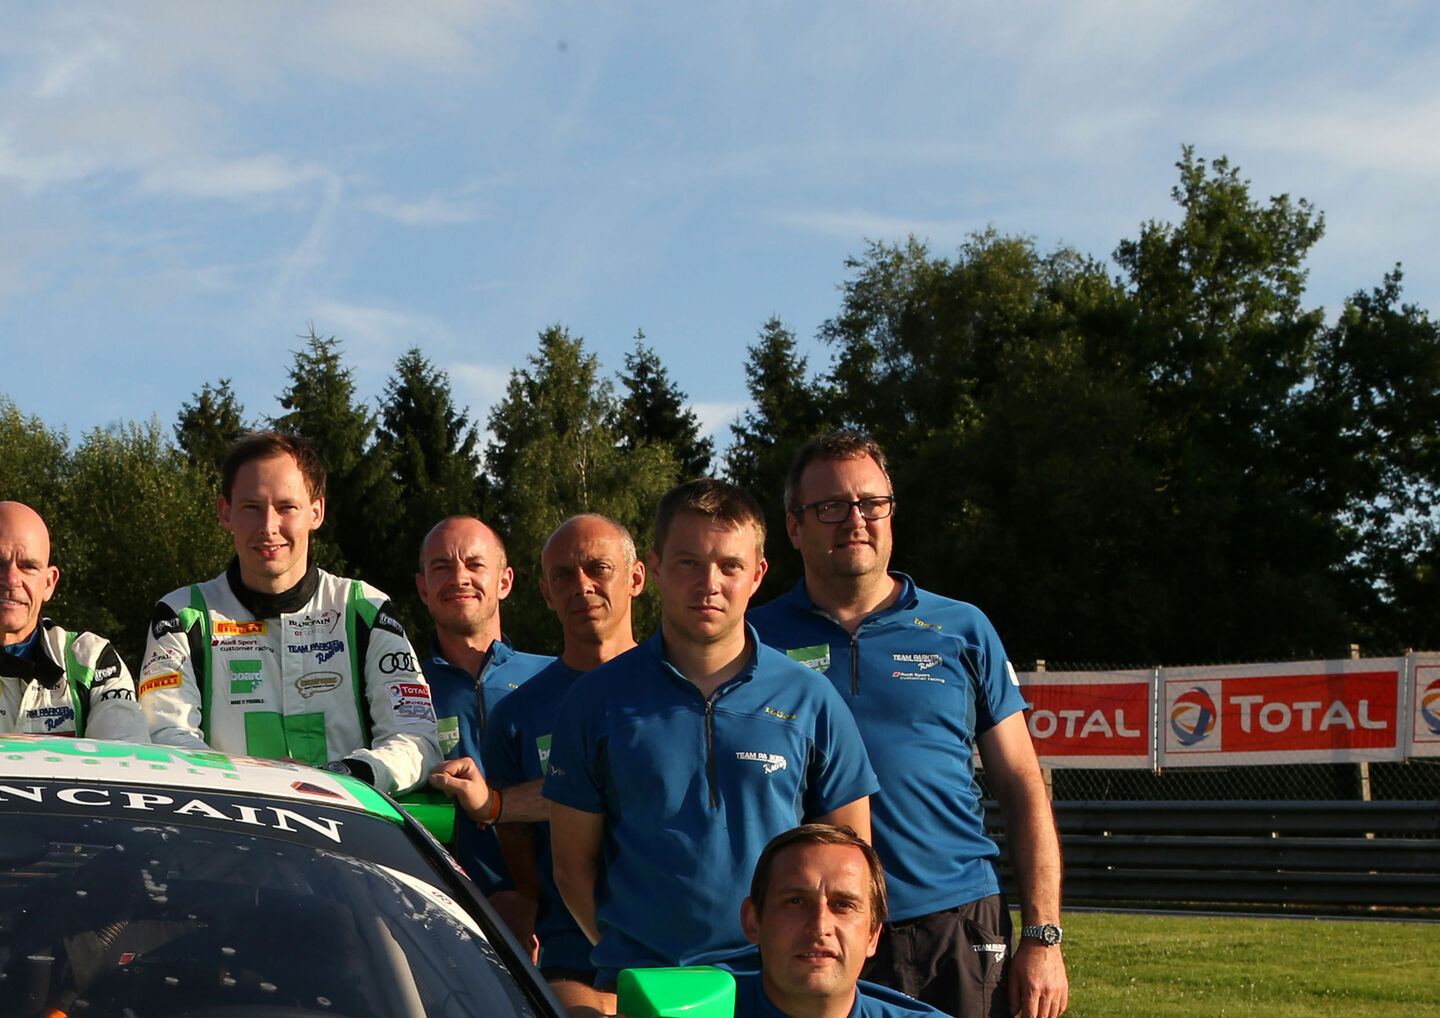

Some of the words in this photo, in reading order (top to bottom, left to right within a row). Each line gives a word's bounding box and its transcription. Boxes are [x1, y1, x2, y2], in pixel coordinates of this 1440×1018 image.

[288, 644, 309, 653] TEAM
[310, 640, 341, 652] PARKER
[893, 654, 913, 662] TEAM
[913, 654, 939, 663] PARKER
[401, 686, 427, 695] TOTAL
[1229, 695, 1387, 733] TOTAL
[1026, 701, 1141, 740] OTAL
[736, 751, 758, 760] TEAM
